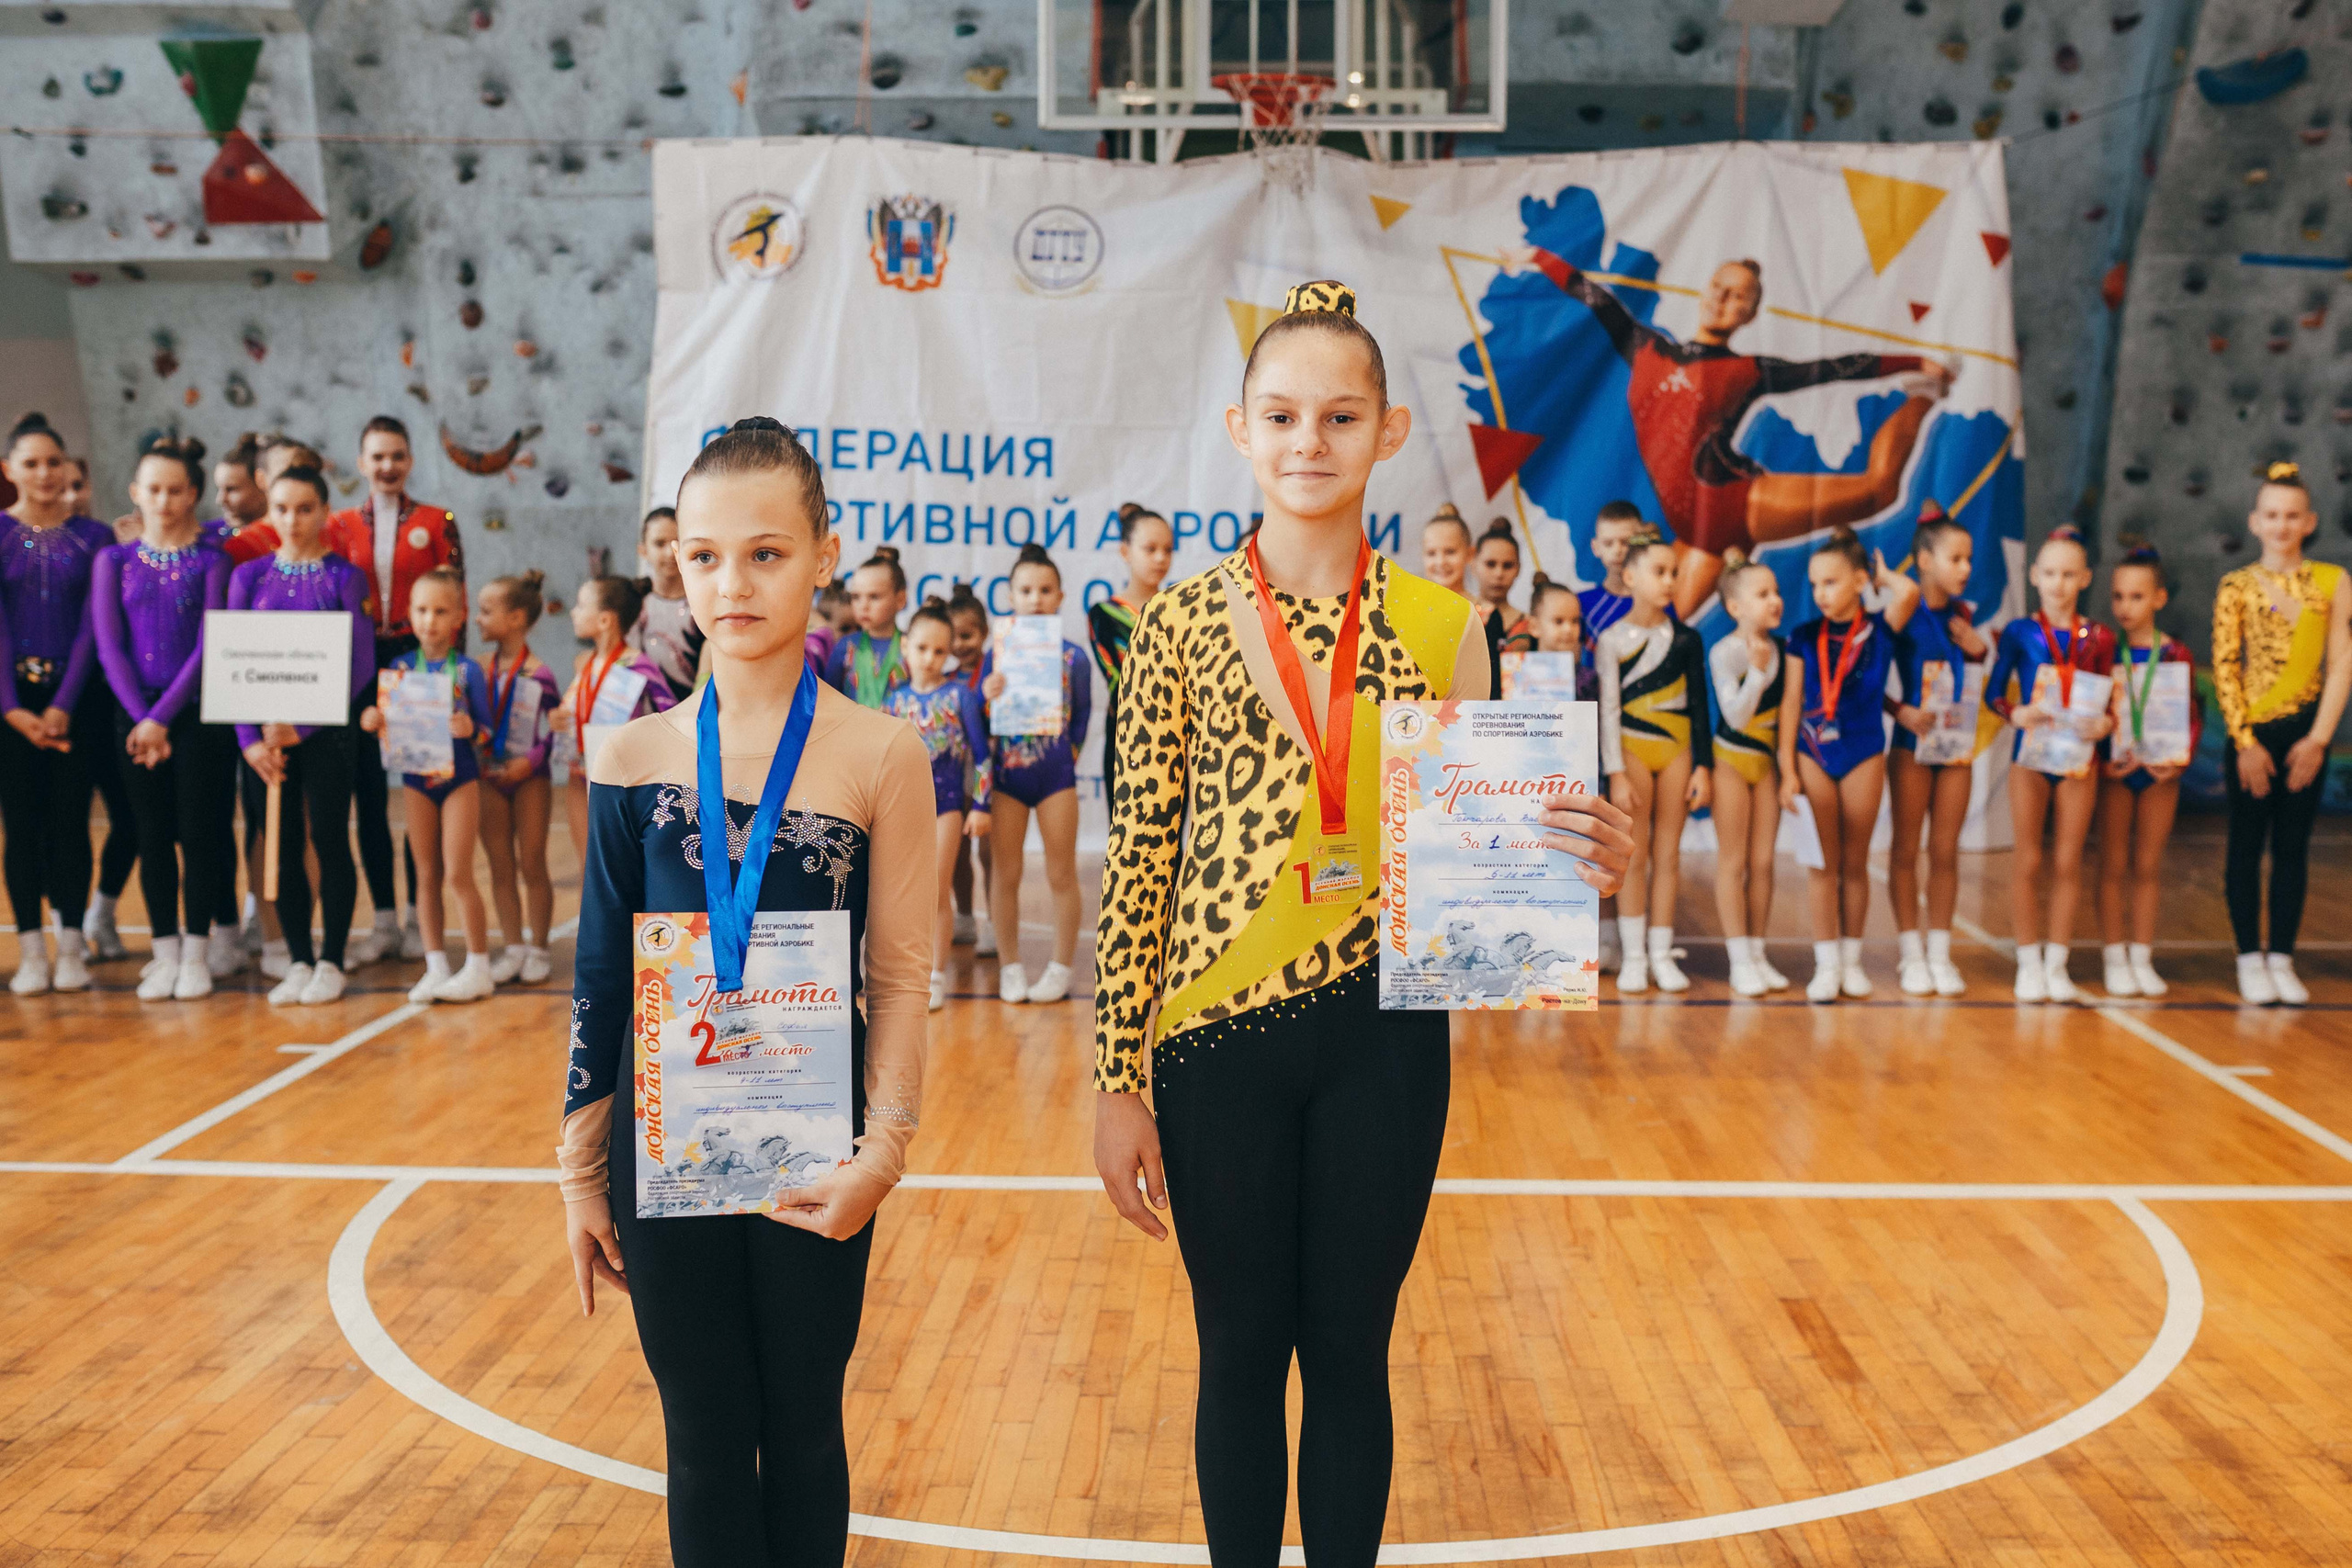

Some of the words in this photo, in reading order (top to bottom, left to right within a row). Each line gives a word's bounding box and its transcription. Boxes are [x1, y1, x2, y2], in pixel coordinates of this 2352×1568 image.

[827, 497, 1077, 549] РТИВНОЙ
[1096, 510, 1400, 552] АРОИ
[1483, 729, 1528, 738] СПОРТИВНОЙ
[1390, 770, 1408, 843] ОСЕНЬ
[1434, 761, 1589, 815] Грамота
[1458, 831, 1481, 850] За
[1488, 834, 1500, 850] 1
[1506, 838, 1555, 850] мест
[1293, 861, 1312, 904] 1
[1314, 894, 1340, 904] МЕСТО
[1388, 851, 1408, 956] ДОНСКАЯ
[762, 922, 815, 931] РЕГИОНАЛЬНЫЕ
[643, 981, 661, 1054] ОСЕНЬ
[687, 972, 842, 1021] Грамота
[782, 1005, 842, 1013] НАГРАЖДАЕТСЯ
[690, 1021, 721, 1066] 2
[723, 1051, 750, 1062] МЕСТО
[644, 1060, 664, 1165] ДОНСКАЯ
